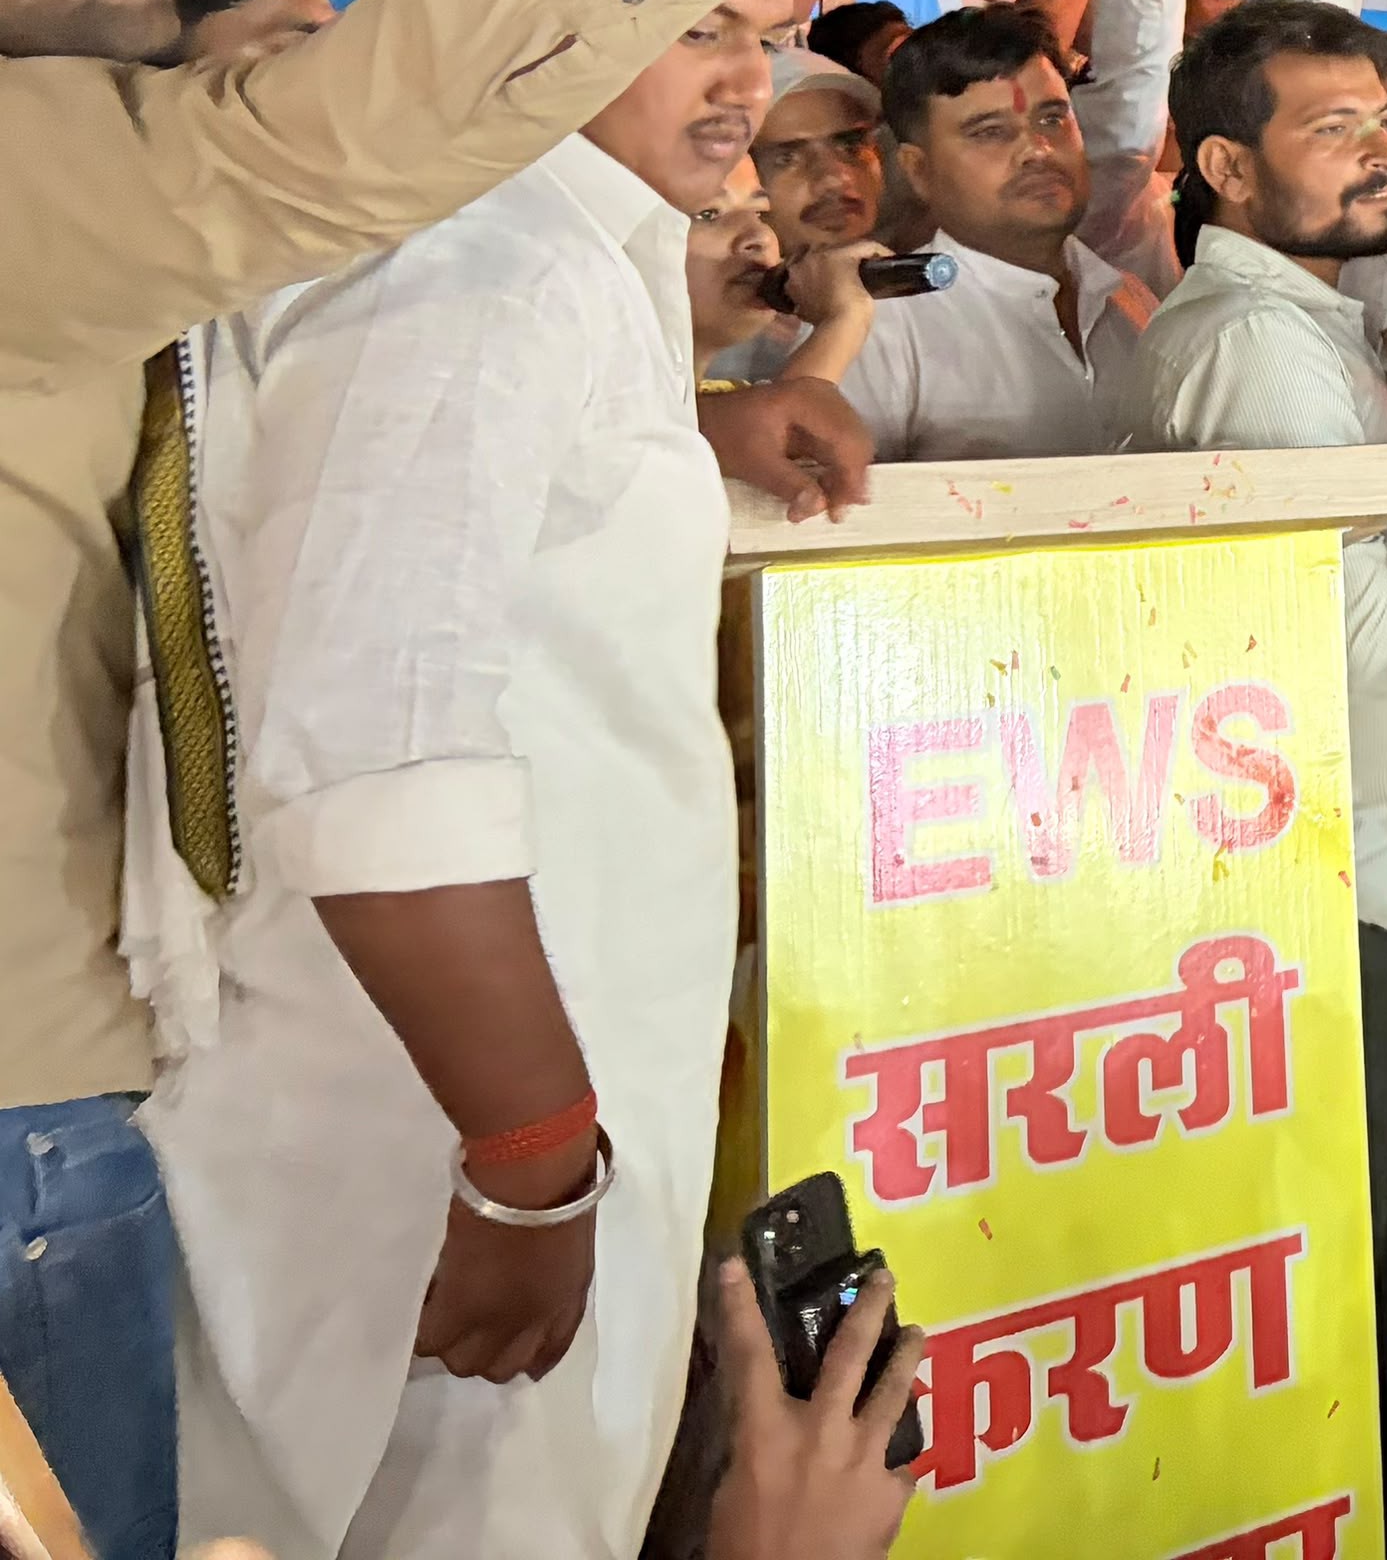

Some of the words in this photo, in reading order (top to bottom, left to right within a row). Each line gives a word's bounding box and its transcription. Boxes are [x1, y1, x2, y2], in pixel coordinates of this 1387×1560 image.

[868, 684, 1297, 904] EWS
[845, 937, 1299, 1202] सरली
[906, 1231, 1302, 1490] करण
